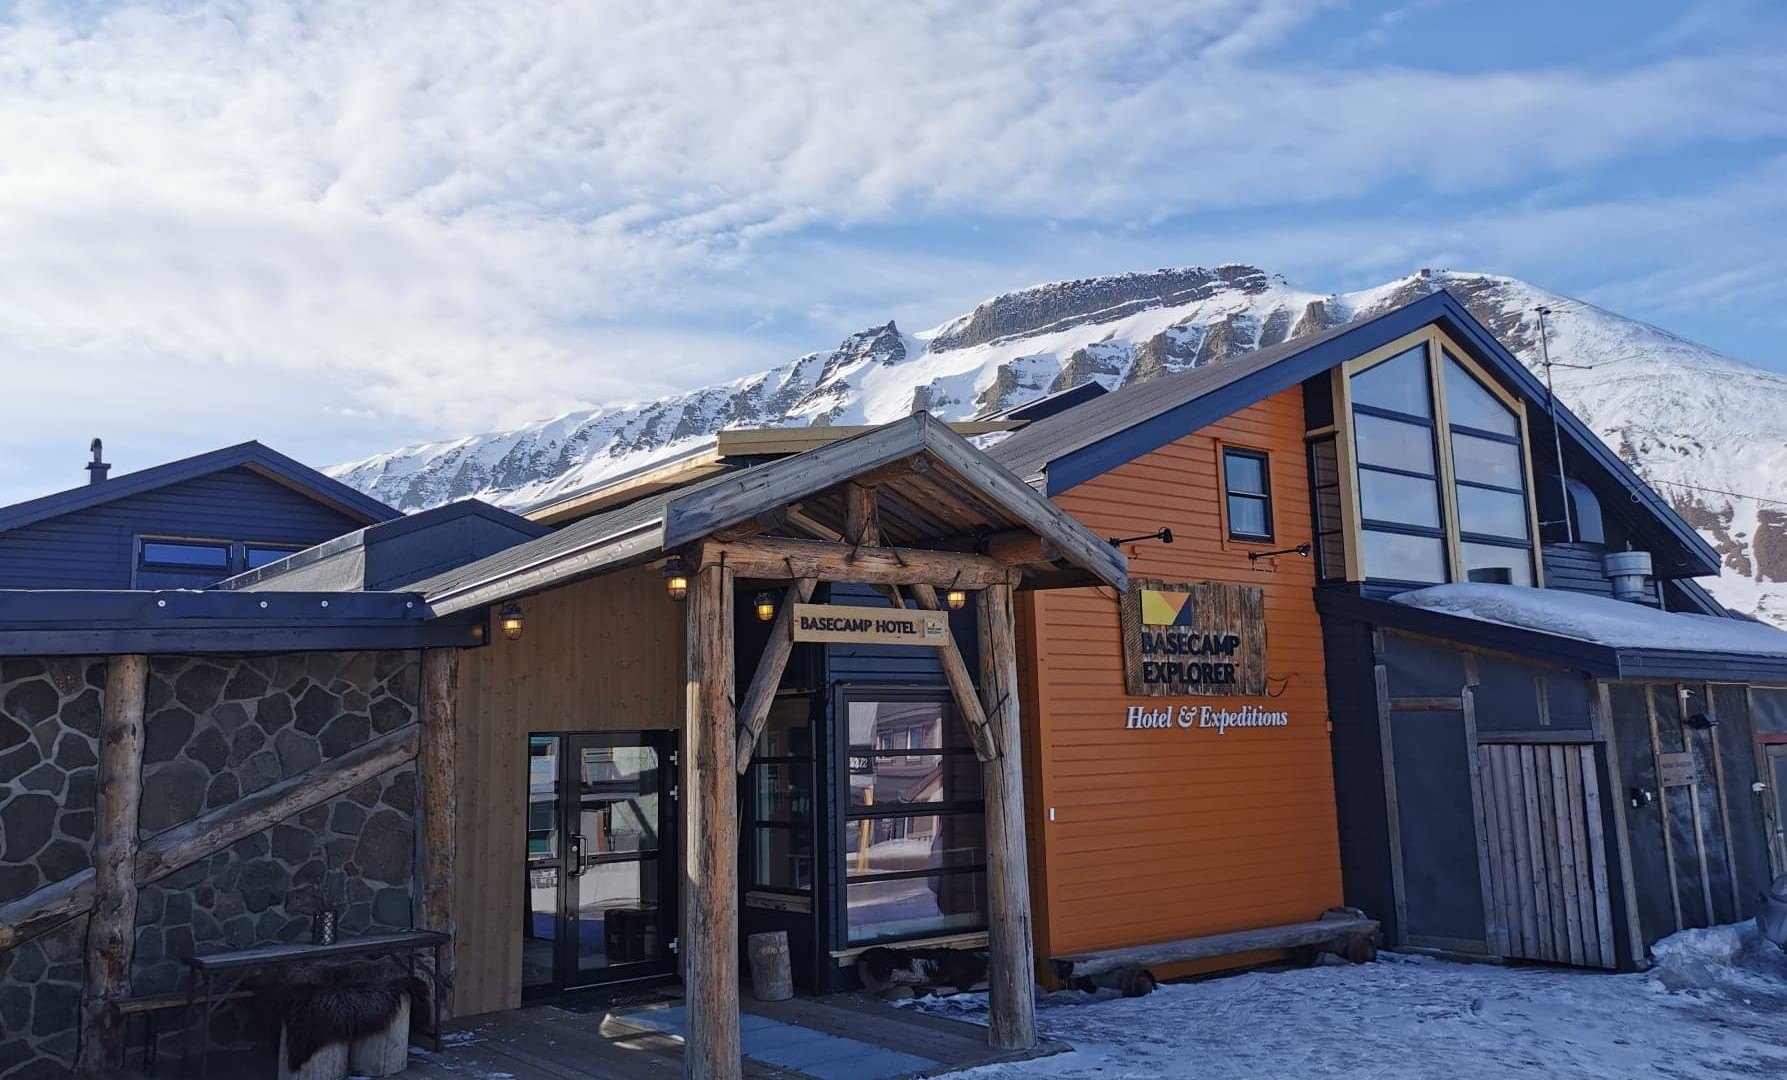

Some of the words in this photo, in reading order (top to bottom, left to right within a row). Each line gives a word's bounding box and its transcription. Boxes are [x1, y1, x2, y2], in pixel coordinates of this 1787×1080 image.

[800, 616, 873, 633] BASECAMP
[876, 619, 917, 635] HOTEL
[1141, 632, 1240, 656] BASECAMP
[1143, 661, 1237, 685] EXPLORER
[1126, 705, 1173, 729] Hotel
[1177, 705, 1198, 728] &
[1199, 704, 1289, 735] Expeditions
